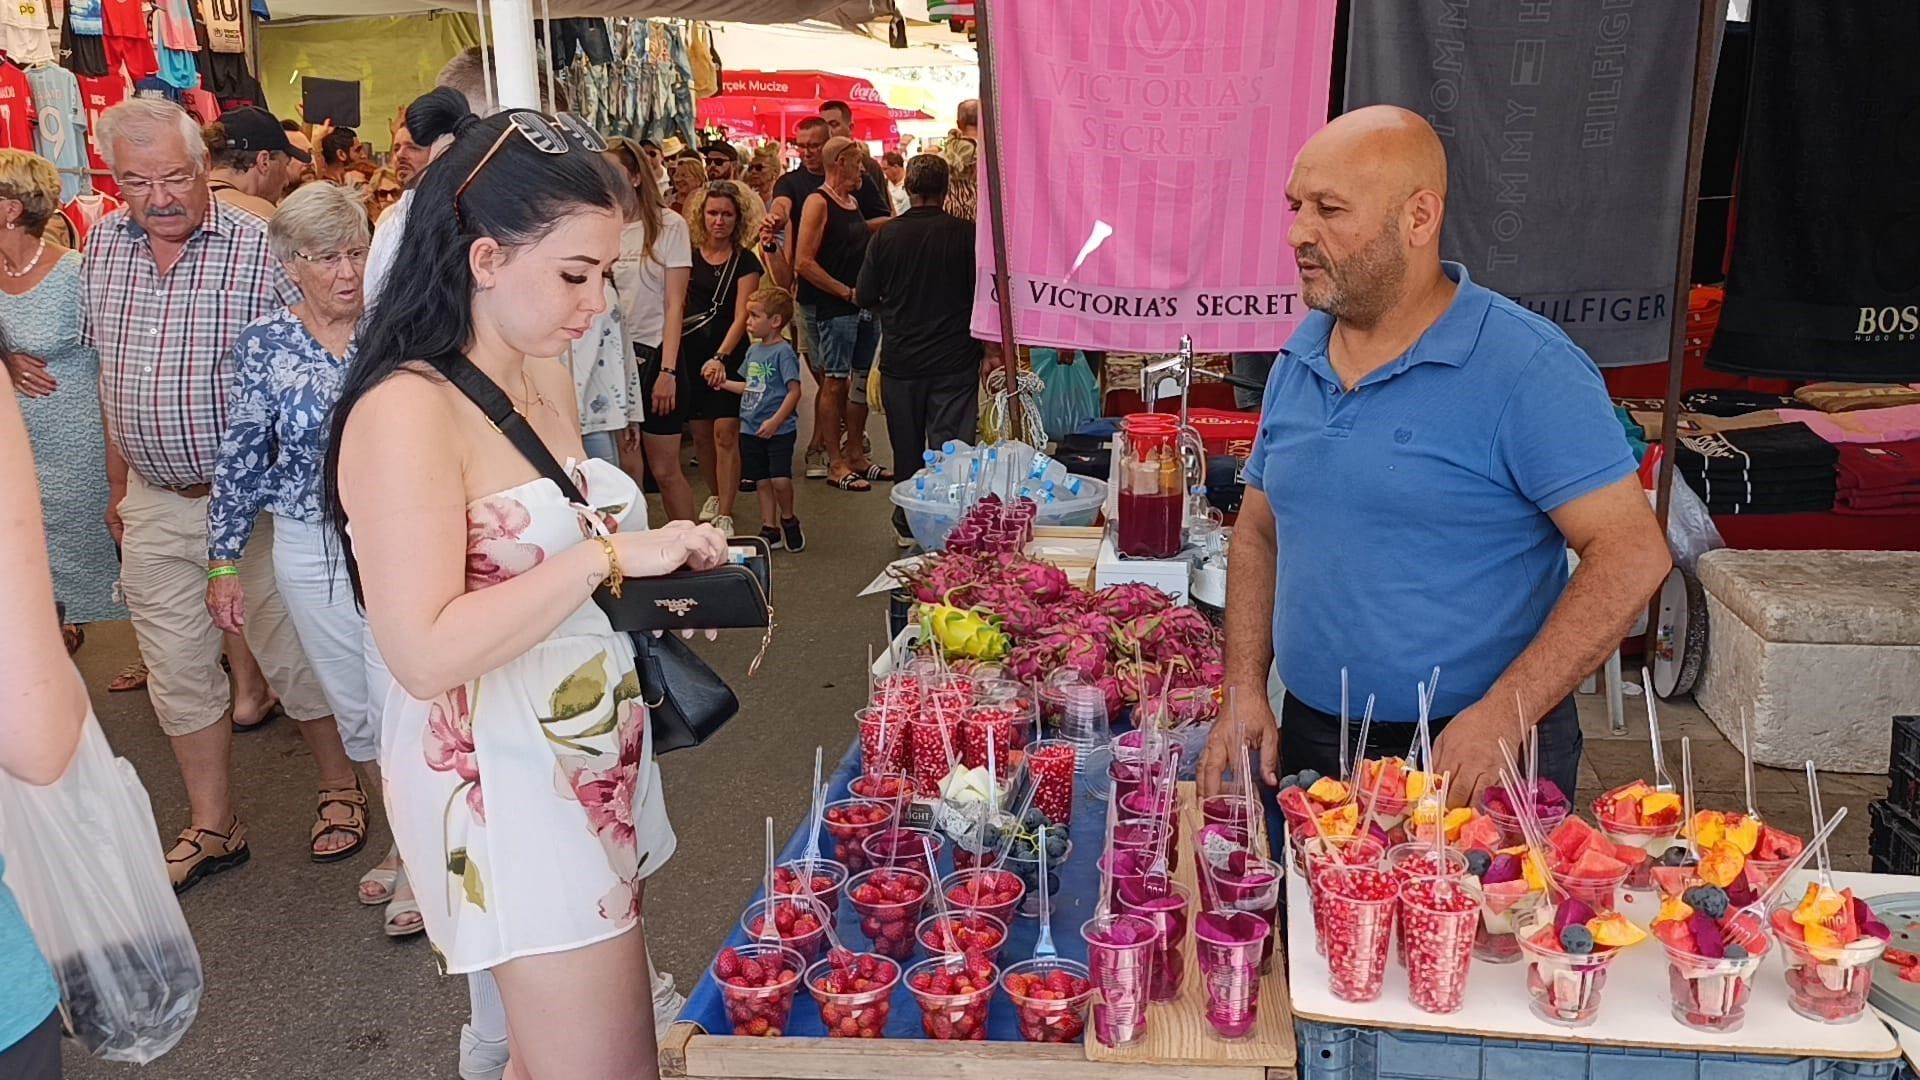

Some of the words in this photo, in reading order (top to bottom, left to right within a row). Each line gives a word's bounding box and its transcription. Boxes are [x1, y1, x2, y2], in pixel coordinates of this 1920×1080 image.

[722, 81, 747, 93] rçek
[749, 80, 789, 92] Mucize
[1049, 61, 1263, 107] VICTORIA'S
[1428, 0, 1469, 137] TOMM
[1582, 0, 1632, 148] HILFIG
[39, 105, 65, 161] 9
[1082, 116, 1223, 155] SECRET
[1487, 99, 1536, 271] TOMMY
[1028, 279, 1178, 318] VICTORIA'S
[1196, 293, 1298, 317] SECRET
[1854, 305, 1919, 335] BOS
